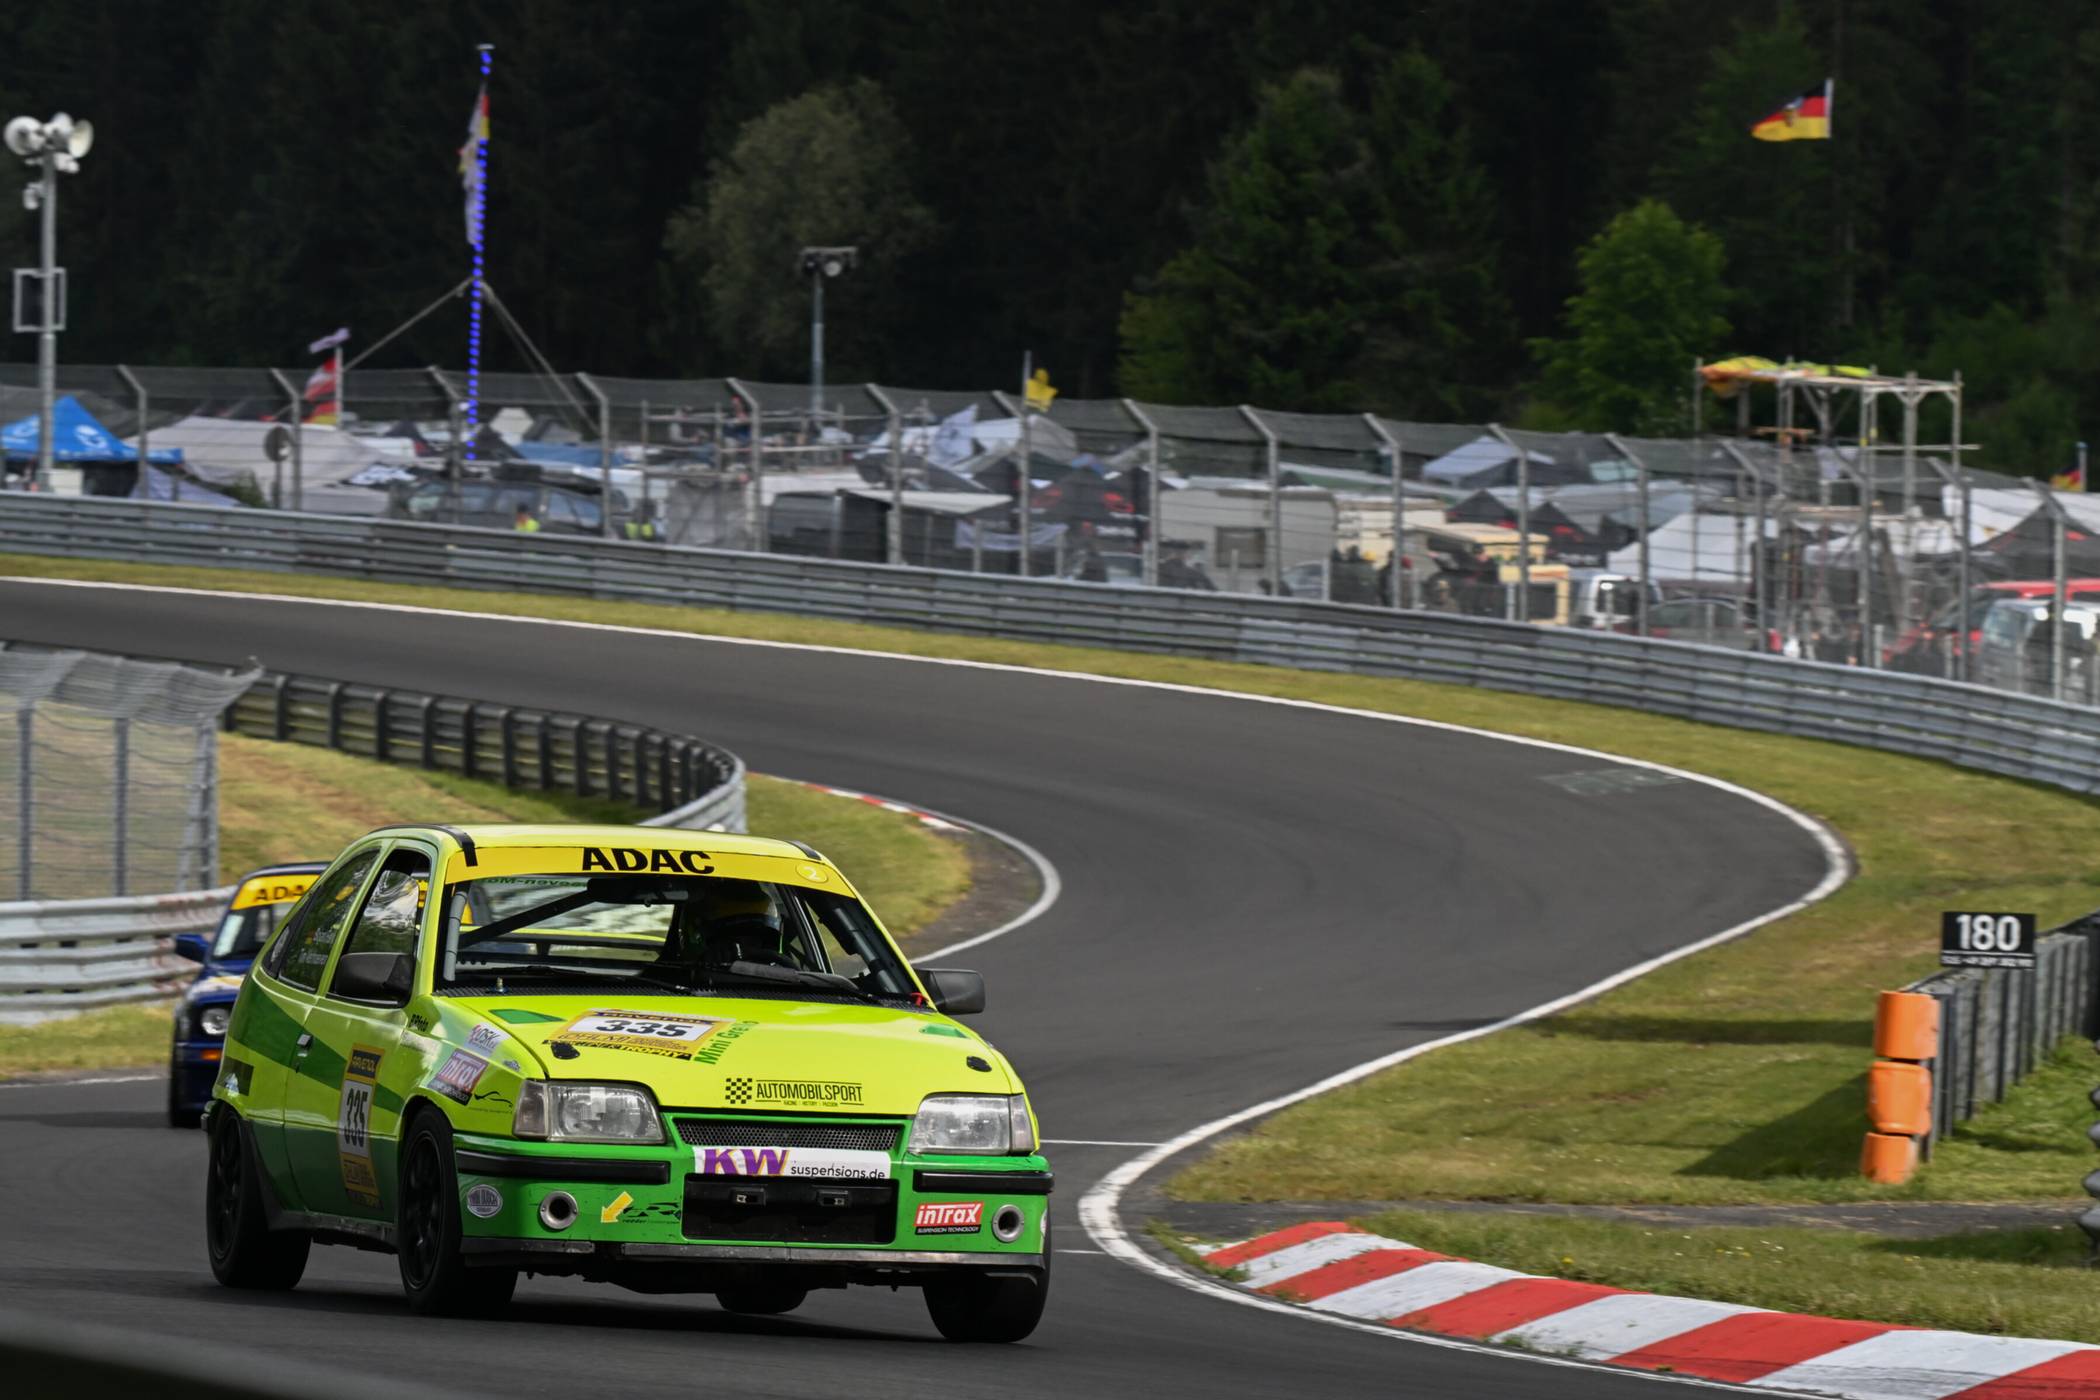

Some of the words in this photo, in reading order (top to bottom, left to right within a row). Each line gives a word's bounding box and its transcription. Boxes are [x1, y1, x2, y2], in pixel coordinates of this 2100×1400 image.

[582, 847, 714, 874] ADAC
[806, 865, 820, 881] 2
[254, 884, 306, 902] ADA
[1956, 914, 2021, 951] 180
[595, 1019, 693, 1038] 335
[694, 1038, 732, 1065] Mini
[756, 1083, 863, 1102] AUTOMOBILSPORT
[343, 1087, 369, 1148] 335
[704, 1148, 790, 1177] KW
[791, 1162, 886, 1180] suspensions.de
[916, 1203, 981, 1225] inTrax
